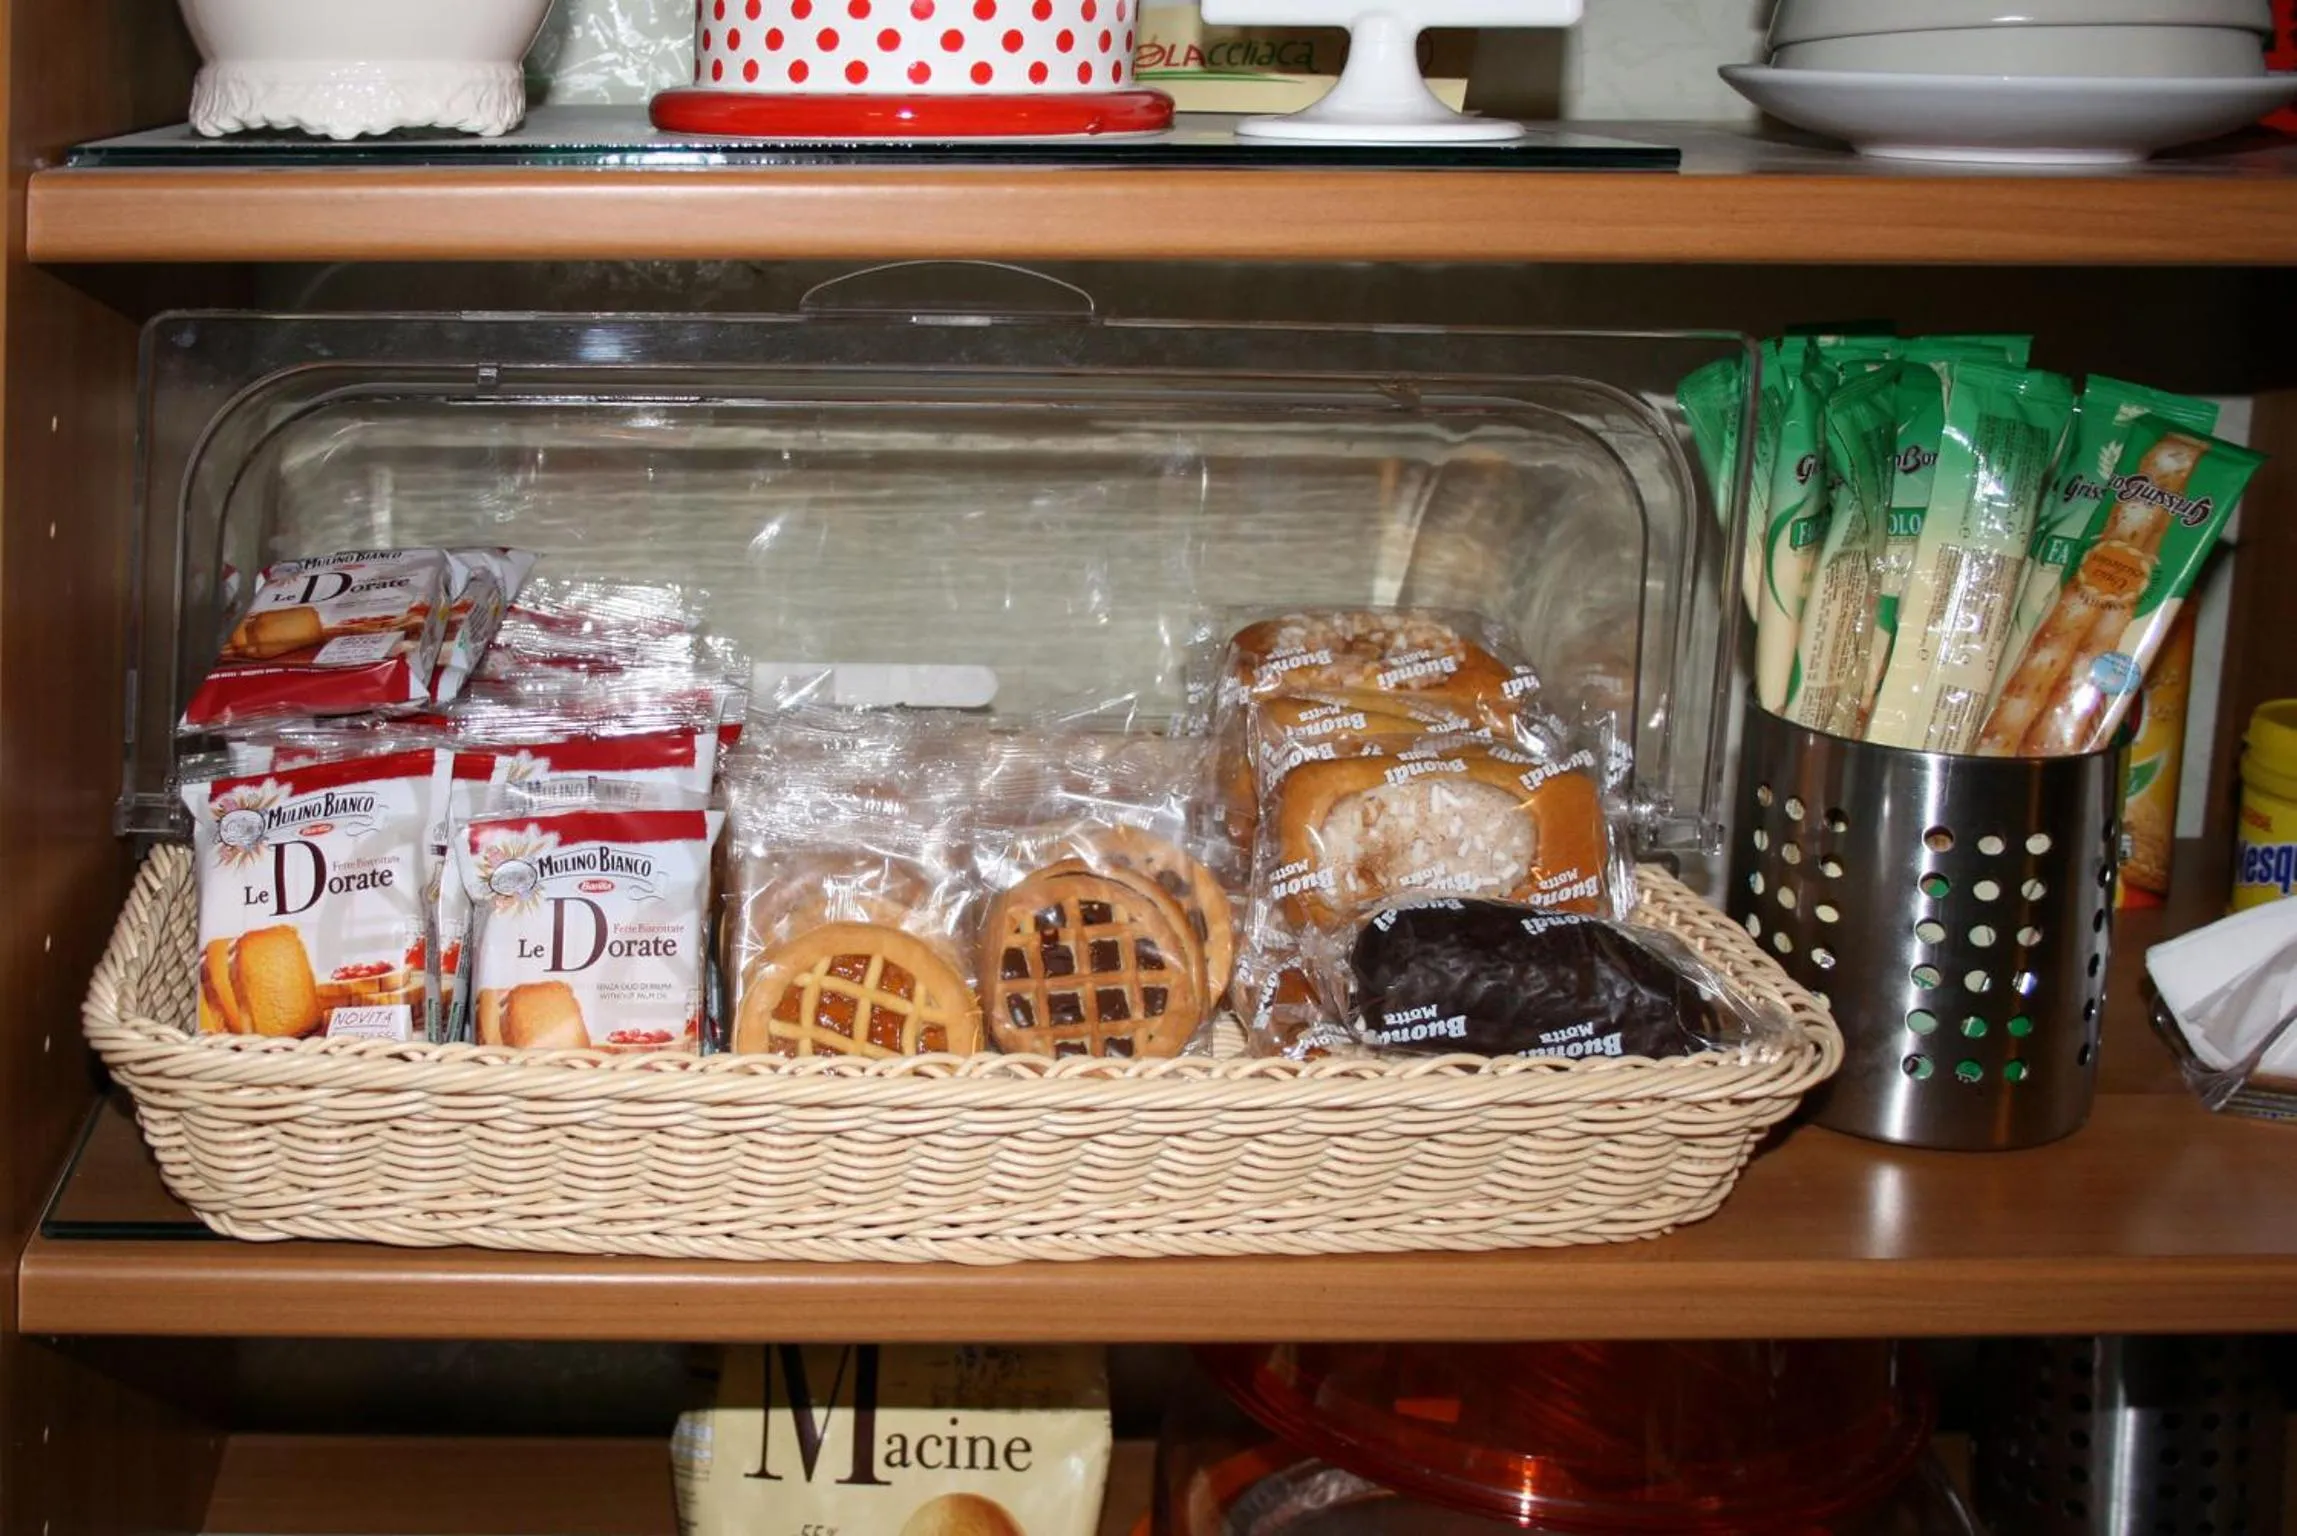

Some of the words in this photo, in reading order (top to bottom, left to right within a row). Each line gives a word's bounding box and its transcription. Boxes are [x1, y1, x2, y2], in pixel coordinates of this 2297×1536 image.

[273, 593, 296, 602] Le
[299, 572, 411, 604] Dorate
[268, 803, 321, 830] MULINO
[324, 792, 375, 817] BIANCO
[244, 886, 269, 906] Le
[268, 840, 394, 918] Dorate
[538, 854, 597, 878] MULINO
[599, 846, 652, 877] BIANCO
[517, 939, 545, 958] Le
[543, 896, 678, 973] Dorate
[1383, 1004, 1438, 1027] Motta
[1539, 1022, 1594, 1045] Motta
[743, 1343, 1033, 1486] Macine
